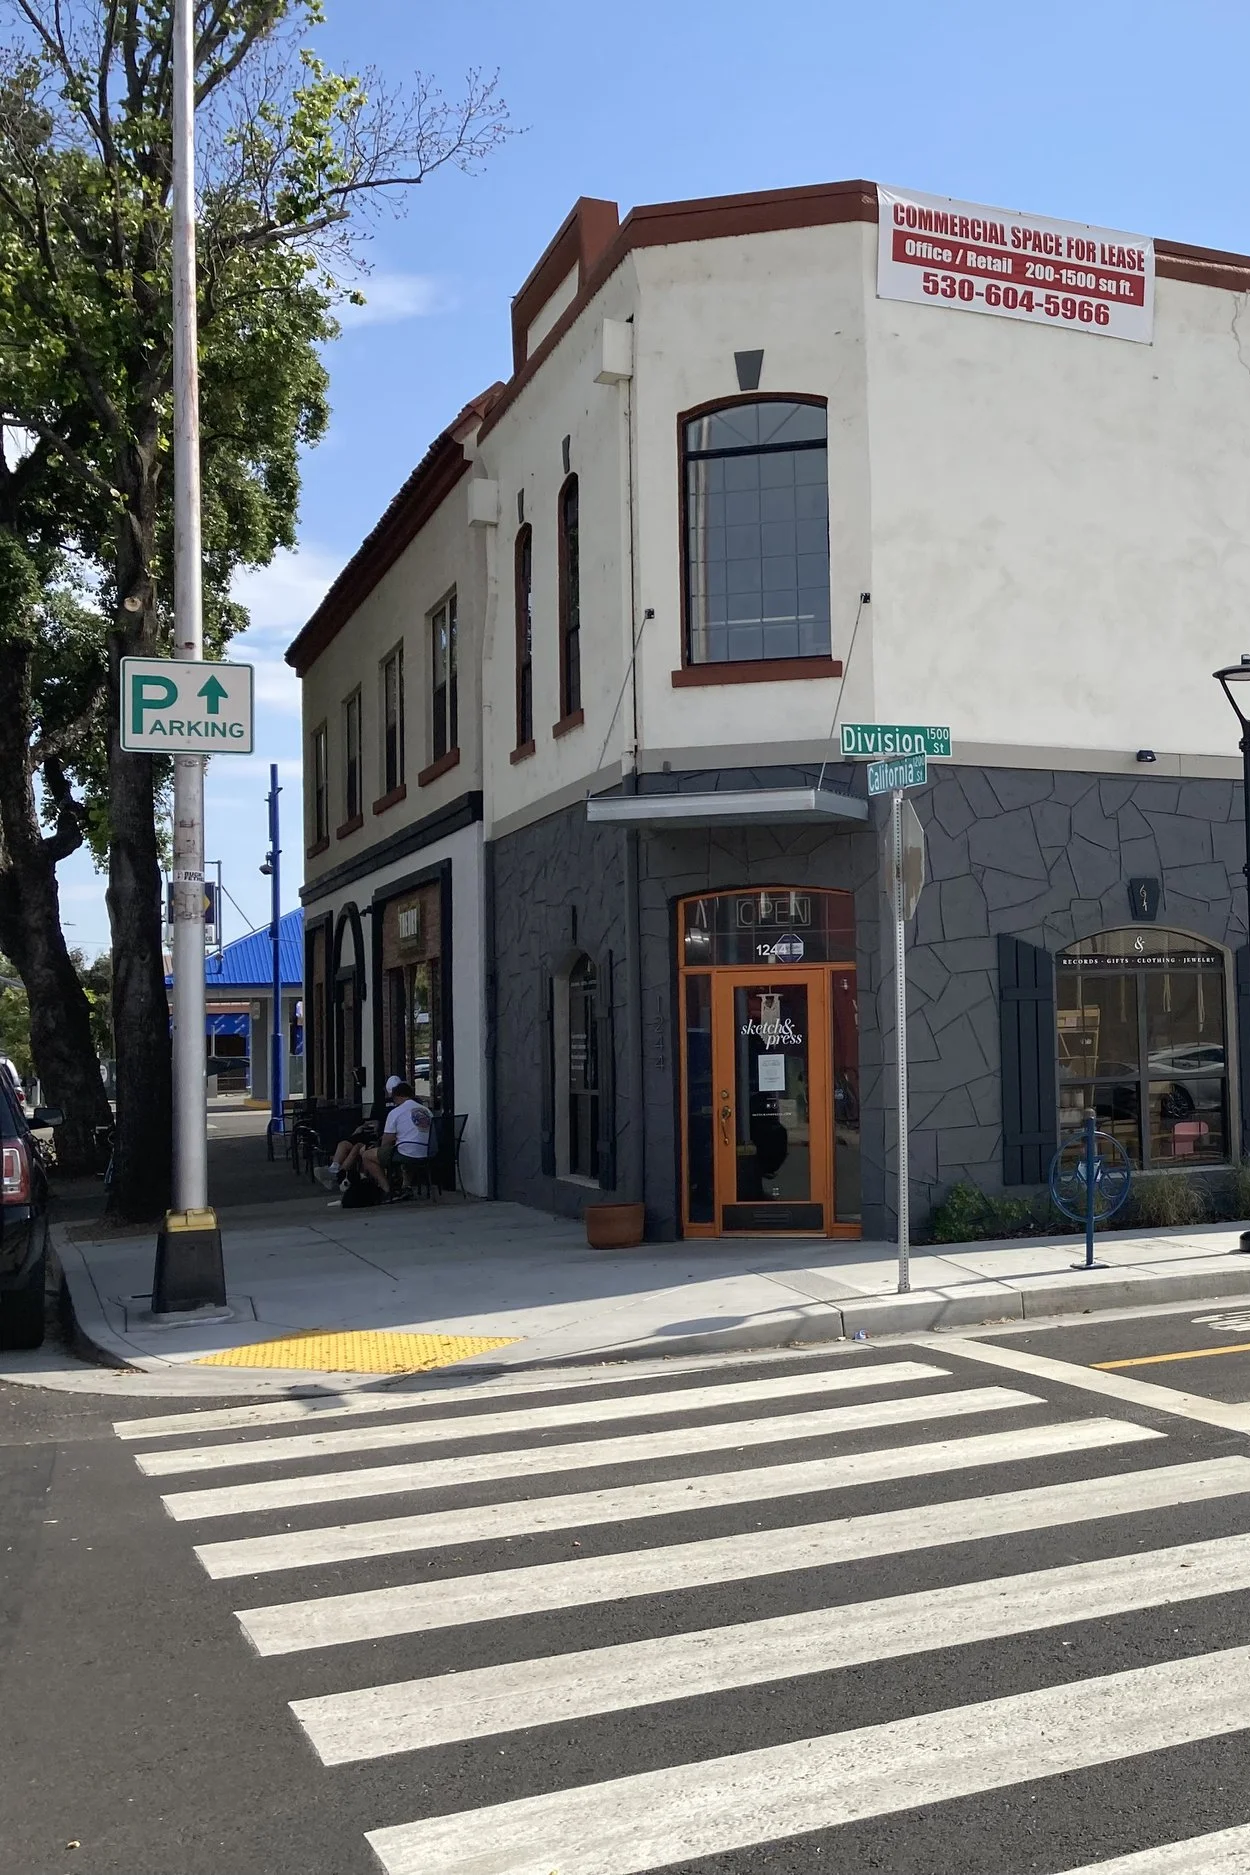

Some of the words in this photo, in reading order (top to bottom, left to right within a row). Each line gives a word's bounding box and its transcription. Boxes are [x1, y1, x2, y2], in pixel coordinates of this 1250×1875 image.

[893, 202, 1007, 246] COMMERCIAL
[1011, 226, 1063, 257] SPACE
[1066, 236, 1096, 263] FOR
[1100, 243, 1145, 272] LEASE
[905, 239, 952, 263] Office
[955, 249, 964, 266] /
[966, 251, 1012, 274] Retail
[1025, 261, 1096, 290] 200-1500
[1098, 277, 1117, 297] sq
[1117, 278, 1134, 297] ft.
[922, 271, 1110, 326] 530-604-5966
[843, 726, 925, 753] Division
[933, 742, 944, 754] St
[926, 728, 949, 740] 1500
[868, 758, 914, 792] California
[916, 770, 924, 782] St
[740, 899, 807, 925] OPEN
[756, 944, 787, 956] 1244
[1134, 935, 1145, 953] &
[765, 1033, 803, 1050] press
